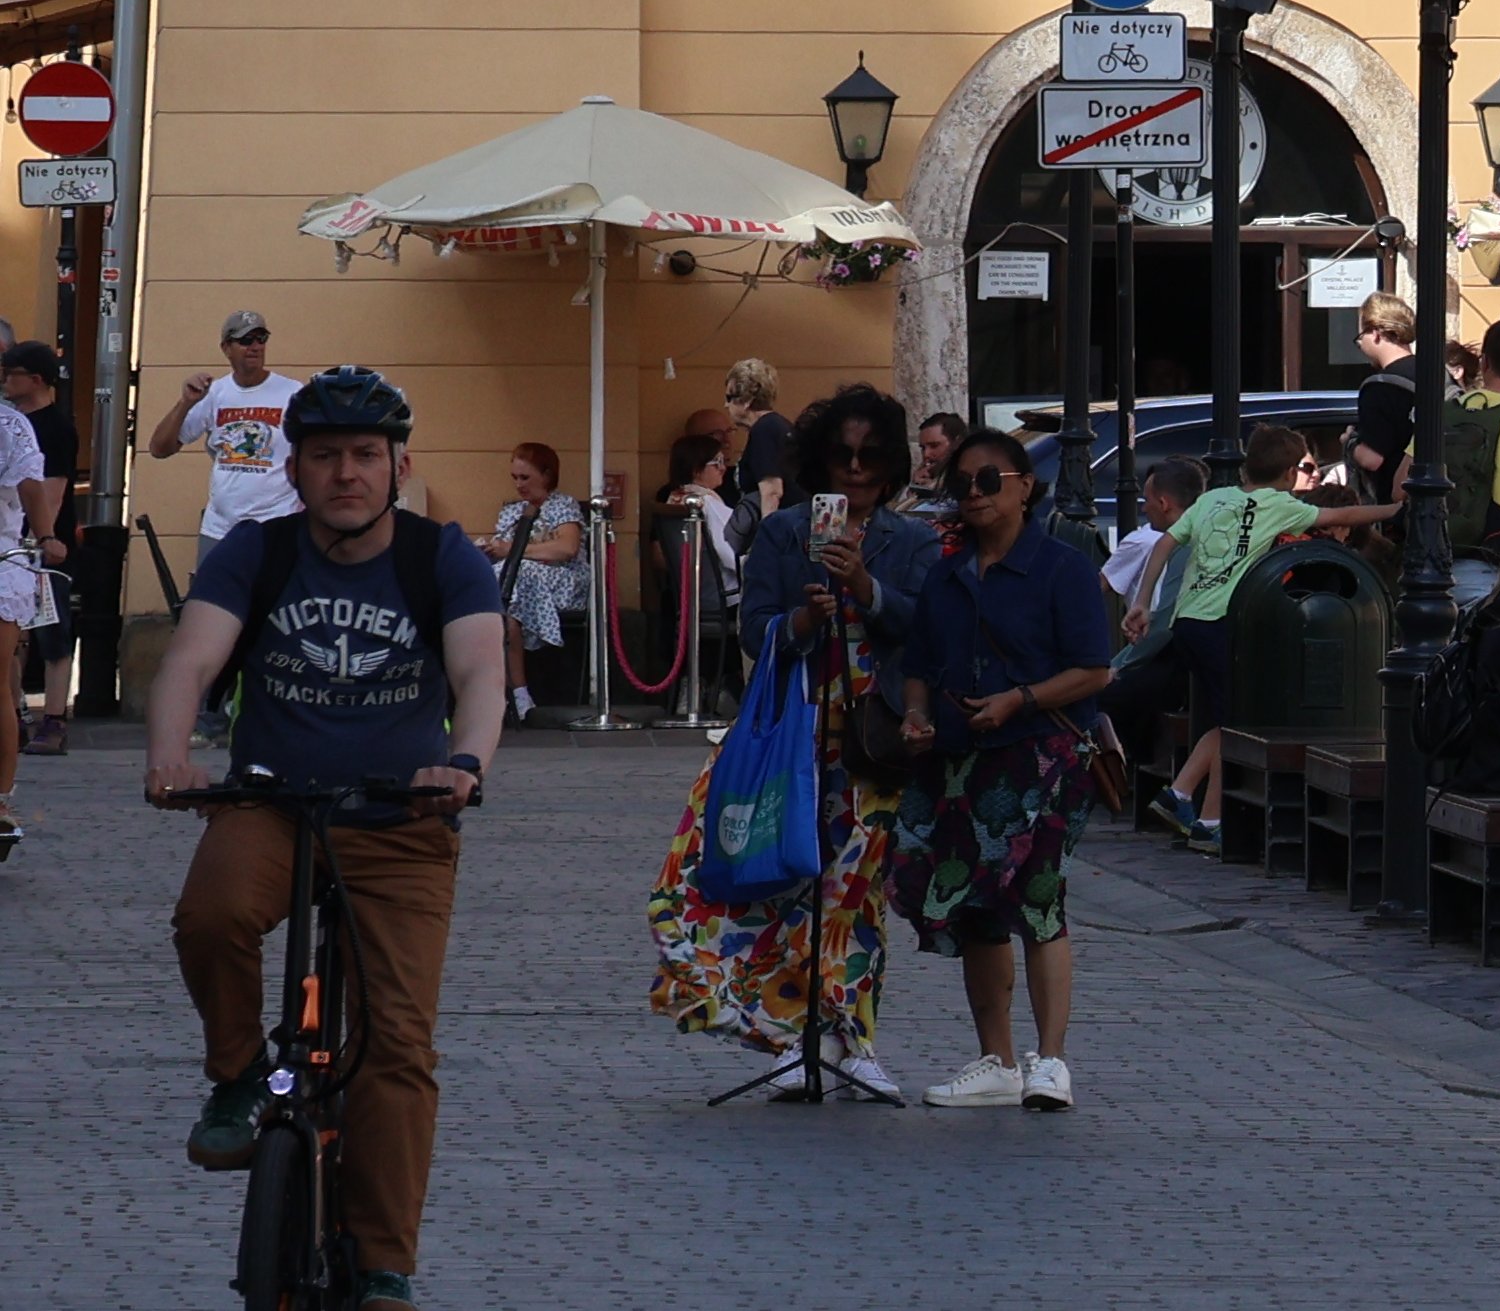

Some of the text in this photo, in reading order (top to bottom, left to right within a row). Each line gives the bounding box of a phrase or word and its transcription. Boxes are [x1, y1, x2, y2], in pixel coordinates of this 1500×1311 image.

[1072, 20, 1173, 38] Nie dotyczy
[25, 165, 109, 179] Nie dotyczy
[1233, 497, 1258, 557] ACHIE
[268, 597, 418, 649] VICTOREM
[263, 674, 331, 705] TRACK
[362, 683, 420, 705] ARGO
